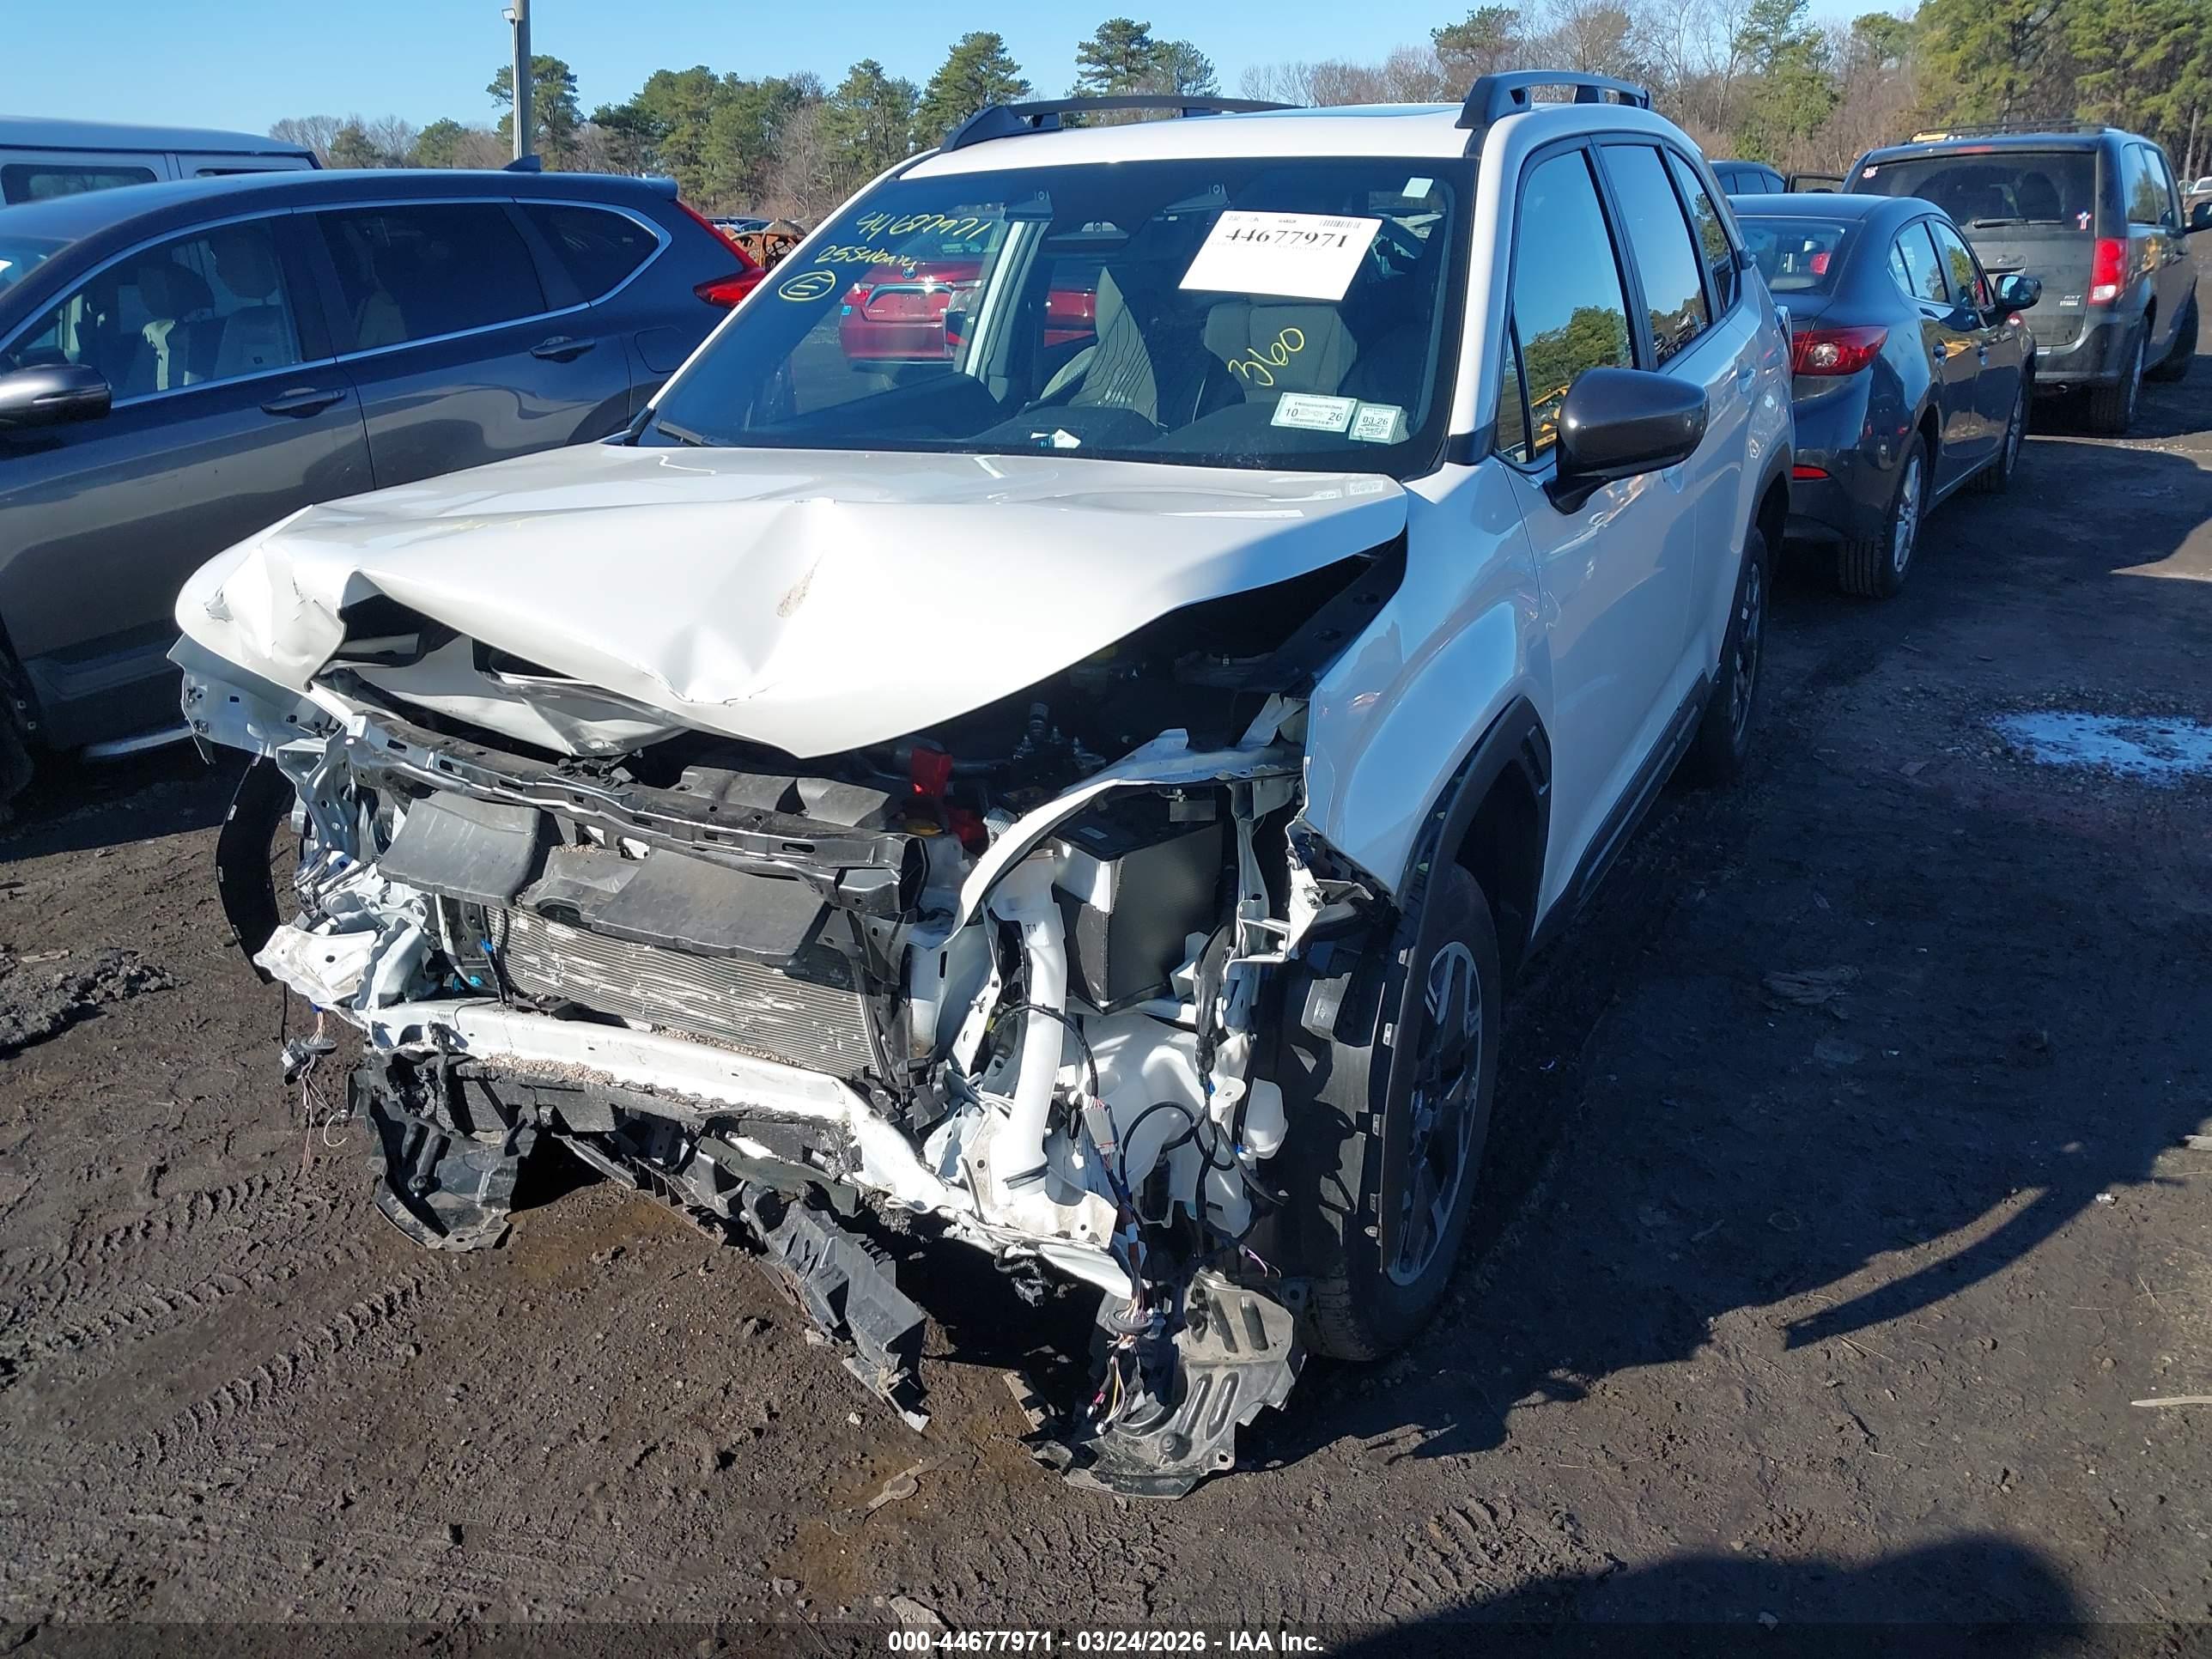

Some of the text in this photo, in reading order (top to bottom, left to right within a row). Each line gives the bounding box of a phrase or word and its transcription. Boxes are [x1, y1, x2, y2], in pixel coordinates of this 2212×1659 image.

[1225, 228, 1349, 248] 44677971
[1228, 327, 1304, 386] 360
[1285, 407, 1299, 417] 10
[1328, 411, 1343, 422] 26
